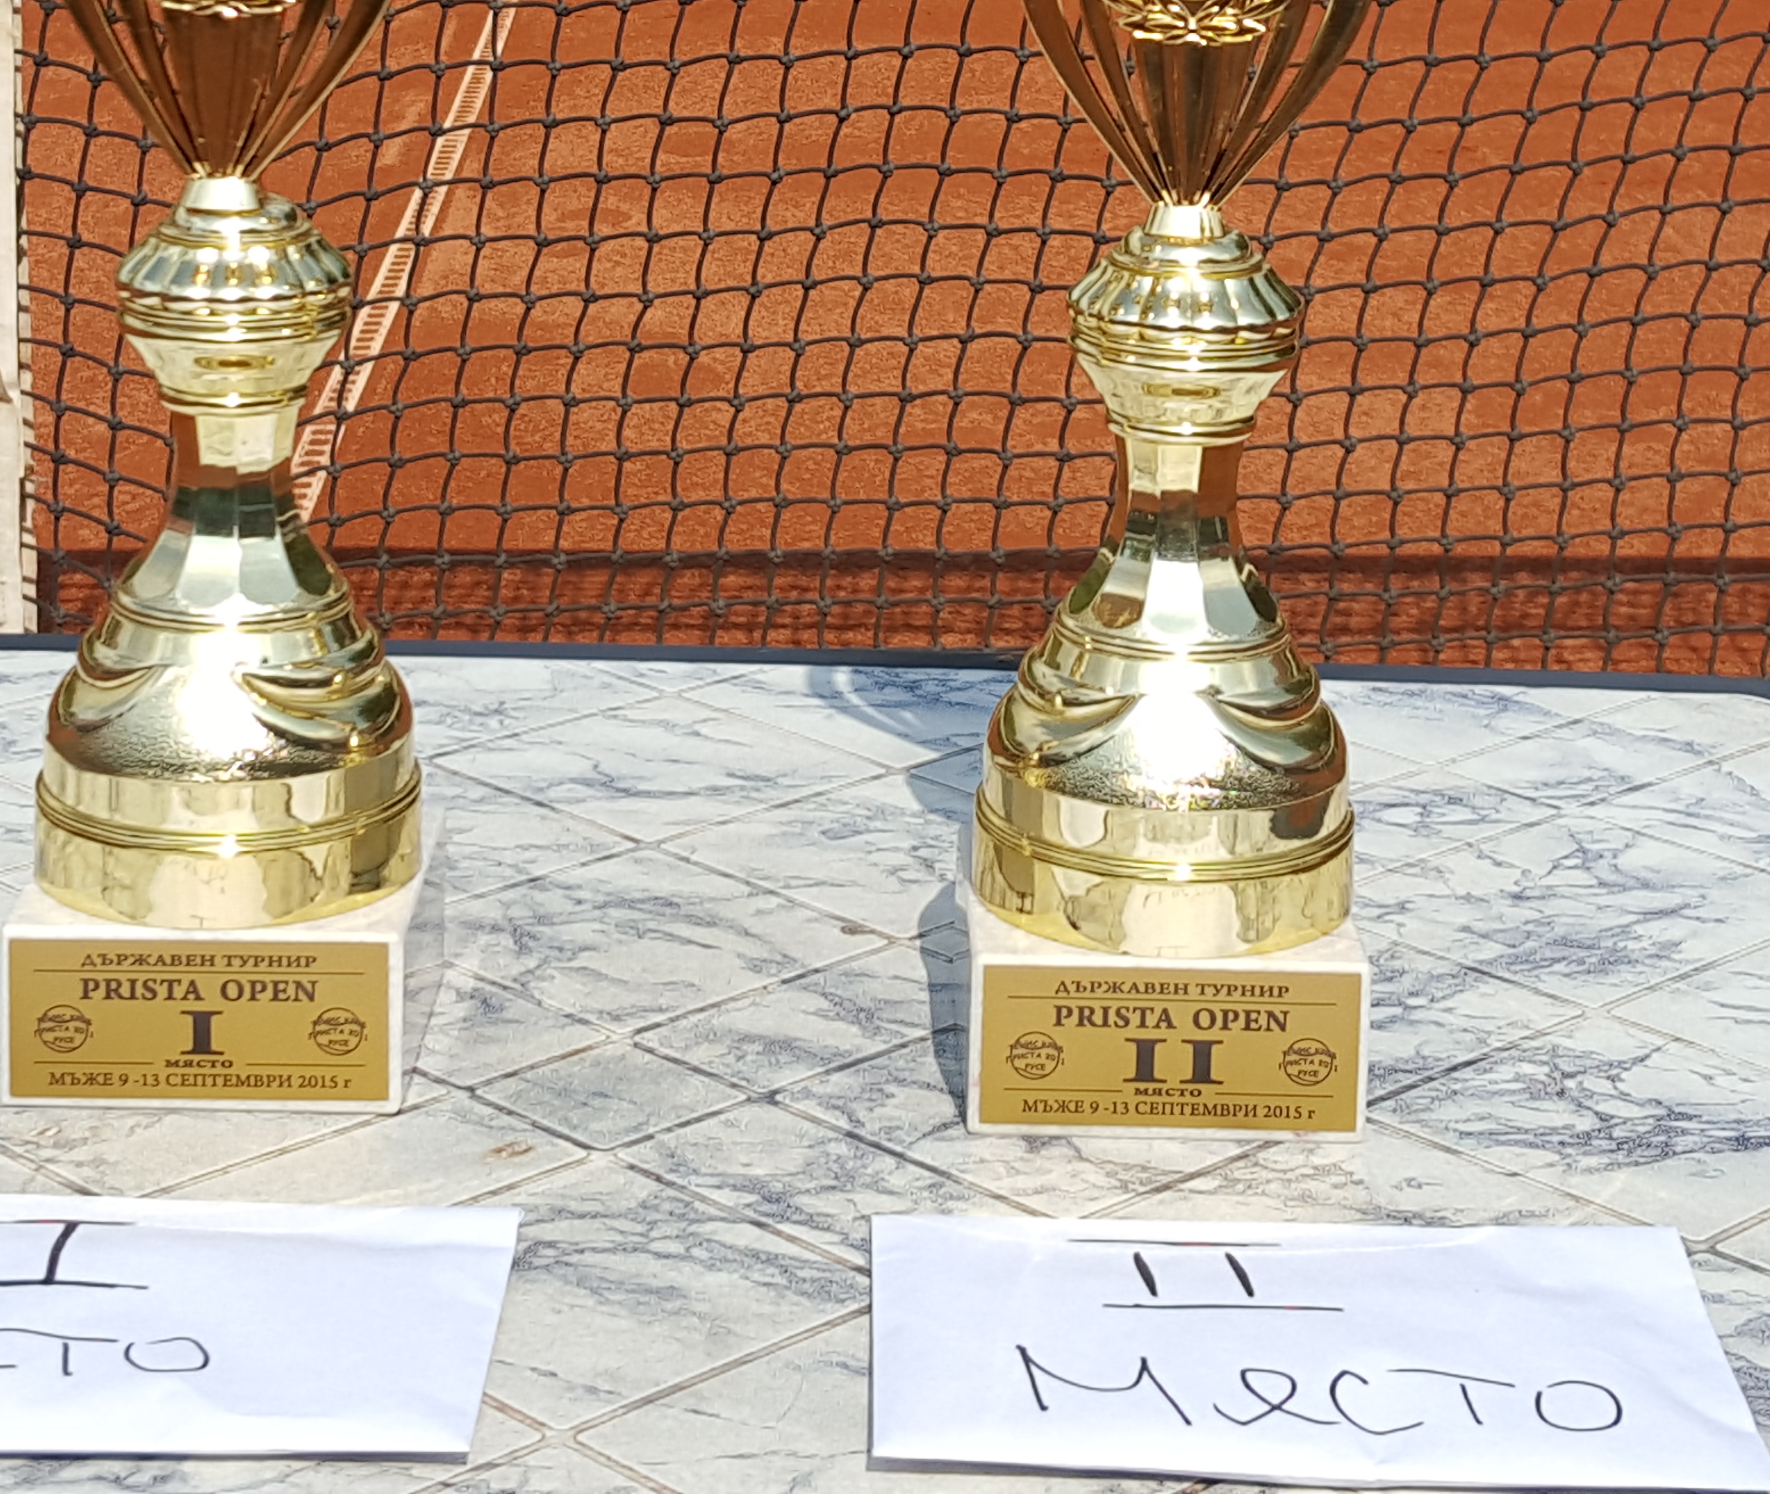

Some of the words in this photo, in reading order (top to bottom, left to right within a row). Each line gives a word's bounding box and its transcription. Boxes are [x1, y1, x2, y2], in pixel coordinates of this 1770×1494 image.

[81, 953, 216, 968] ДЪРЖАВЕН
[221, 954, 317, 969] ТУРНИР
[80, 978, 205, 1001] PRISTA
[220, 979, 319, 1002] OPEN
[1055, 980, 1190, 996] ДЪРЖАВЕН
[1195, 983, 1290, 999] ТУРНИР
[1053, 1004, 1177, 1029] PRISTA
[1192, 1007, 1290, 1032] OPEN
[180, 1010, 225, 1055] I
[48, 1072, 114, 1087] МЪЖЕ
[119, 1072, 129, 1087] 9
[166, 1072, 293, 1089] СЕПТЕМВРИ
[298, 1074, 339, 1089] 2015
[1022, 1099, 1085, 1114] МЪЖЕ
[1089, 1100, 1099, 1114] 9
[1135, 1101, 1258, 1119] СЕПТЕМВРИ
[1263, 1105, 1302, 1119] 2015
